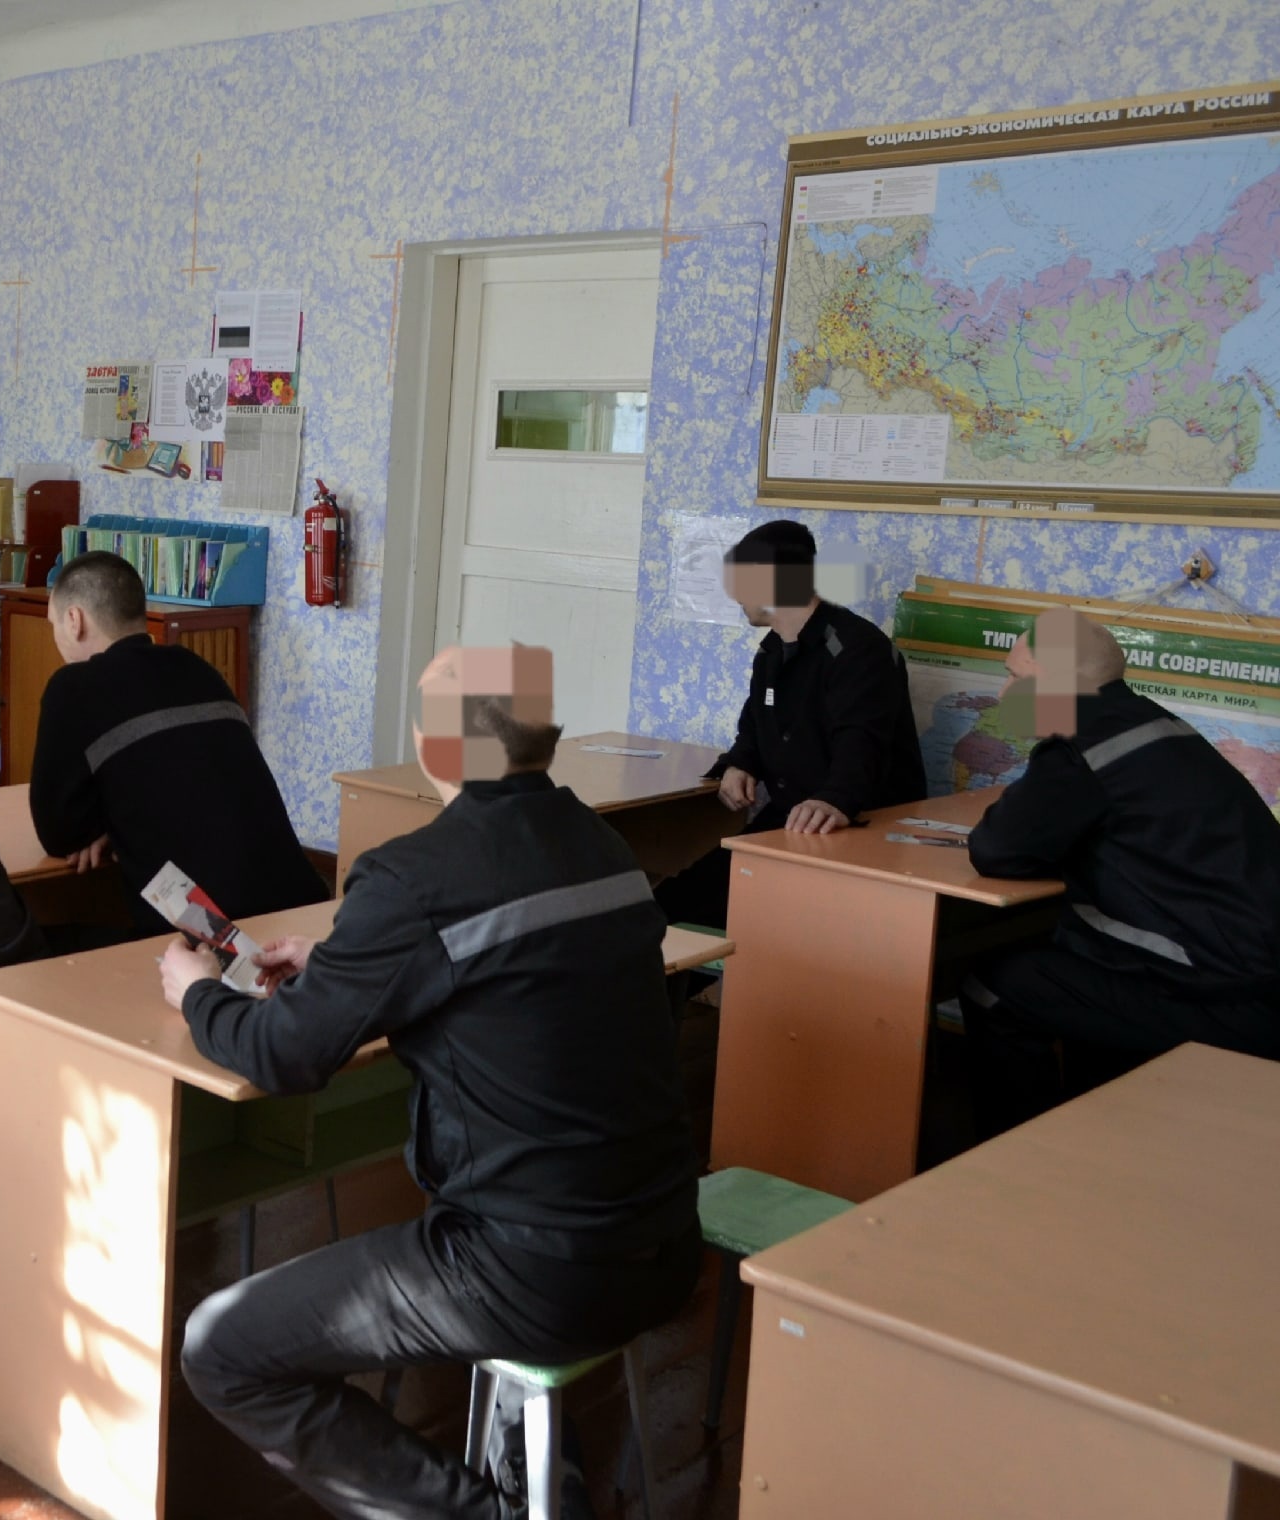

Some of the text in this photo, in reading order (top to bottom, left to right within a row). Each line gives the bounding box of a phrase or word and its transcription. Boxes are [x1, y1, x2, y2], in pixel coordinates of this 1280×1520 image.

[866, 92, 1270, 146] СОЦИАЛЬНО-ЭКОНОМИЧЕСКАЯ КАРТА РОССИИ
[983, 630, 1018, 649] ТИП
[1159, 653, 1280, 684] СОВРЕМЕНН
[1182, 689, 1218, 703] КАРТА
[1224, 696, 1258, 709] МИРА
